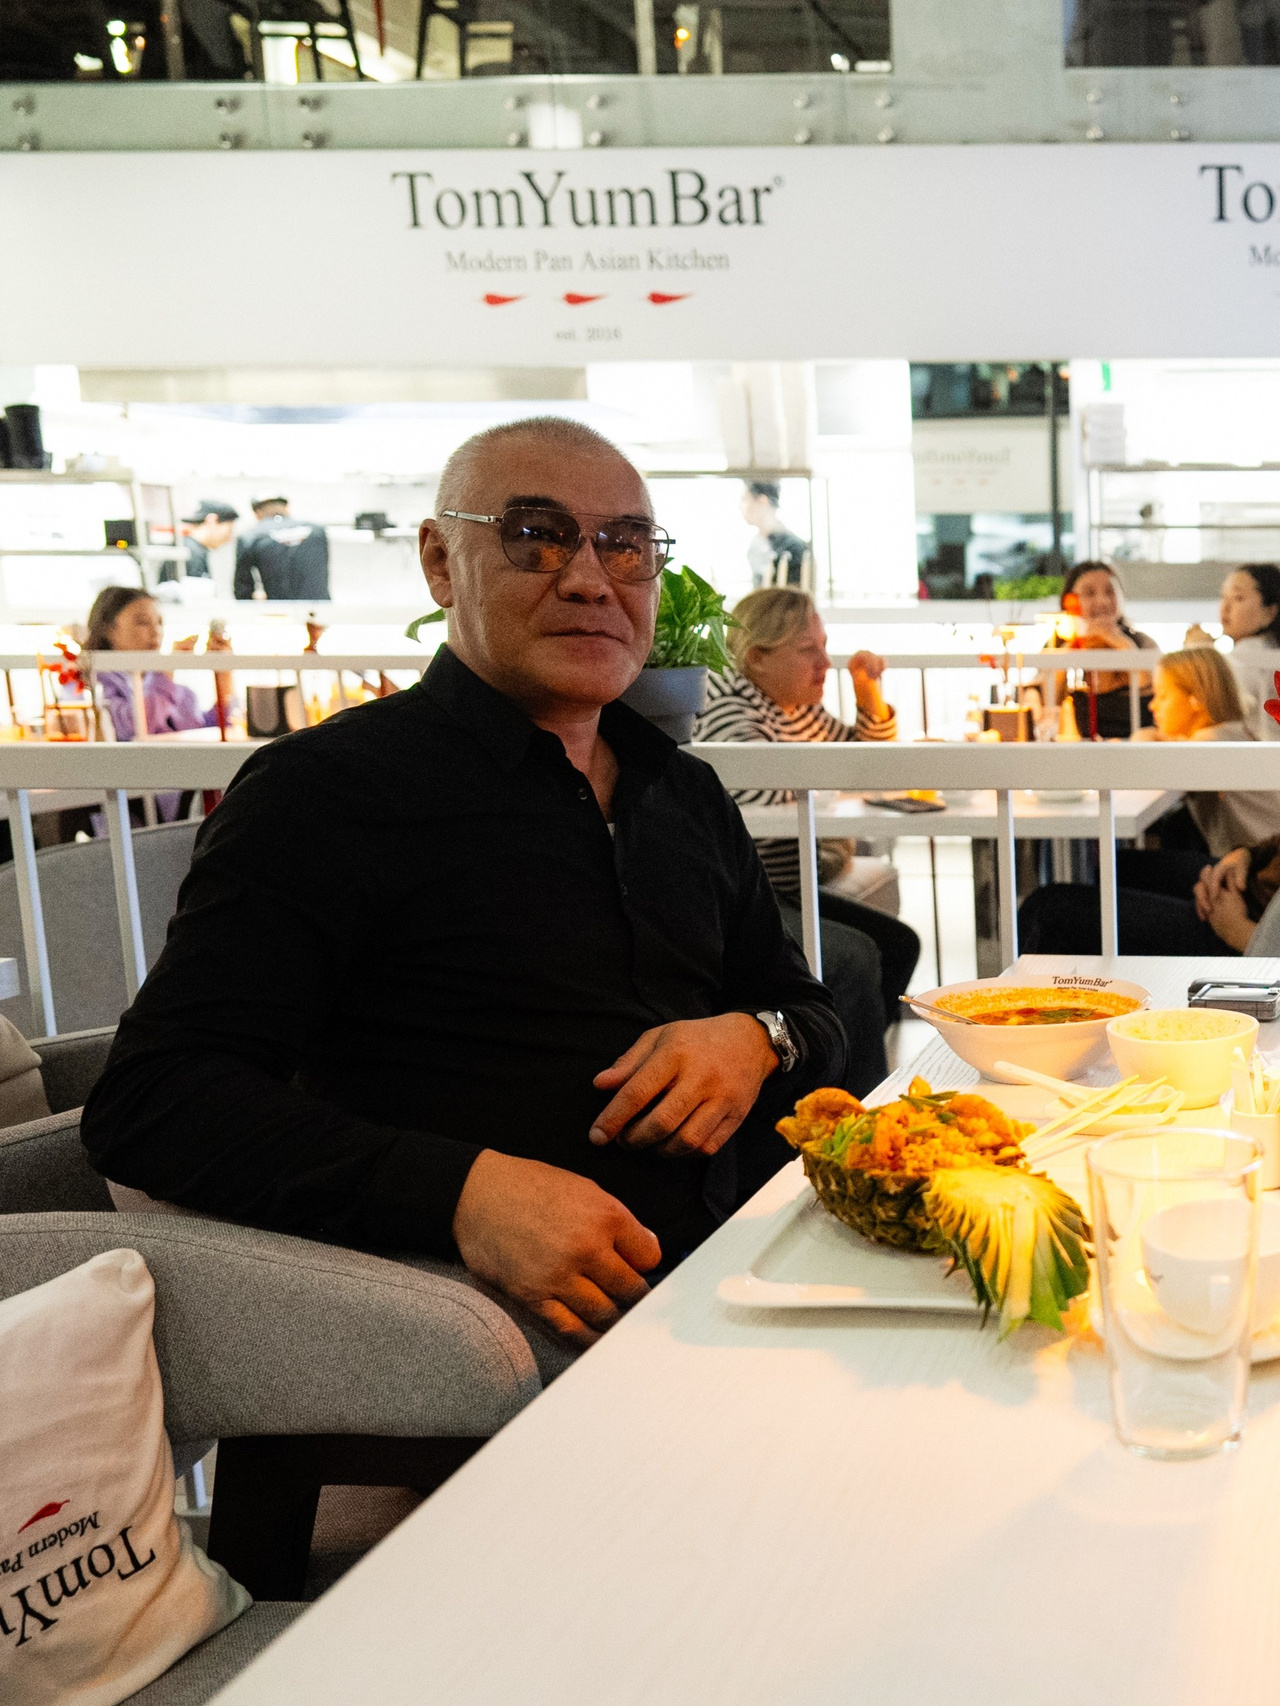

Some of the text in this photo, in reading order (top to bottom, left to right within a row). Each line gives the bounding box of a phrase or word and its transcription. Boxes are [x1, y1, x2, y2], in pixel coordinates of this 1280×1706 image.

[445, 247, 731, 272] Modern Pan Asian Kitchen
[0, 1511, 101, 1576] Modern Pa
